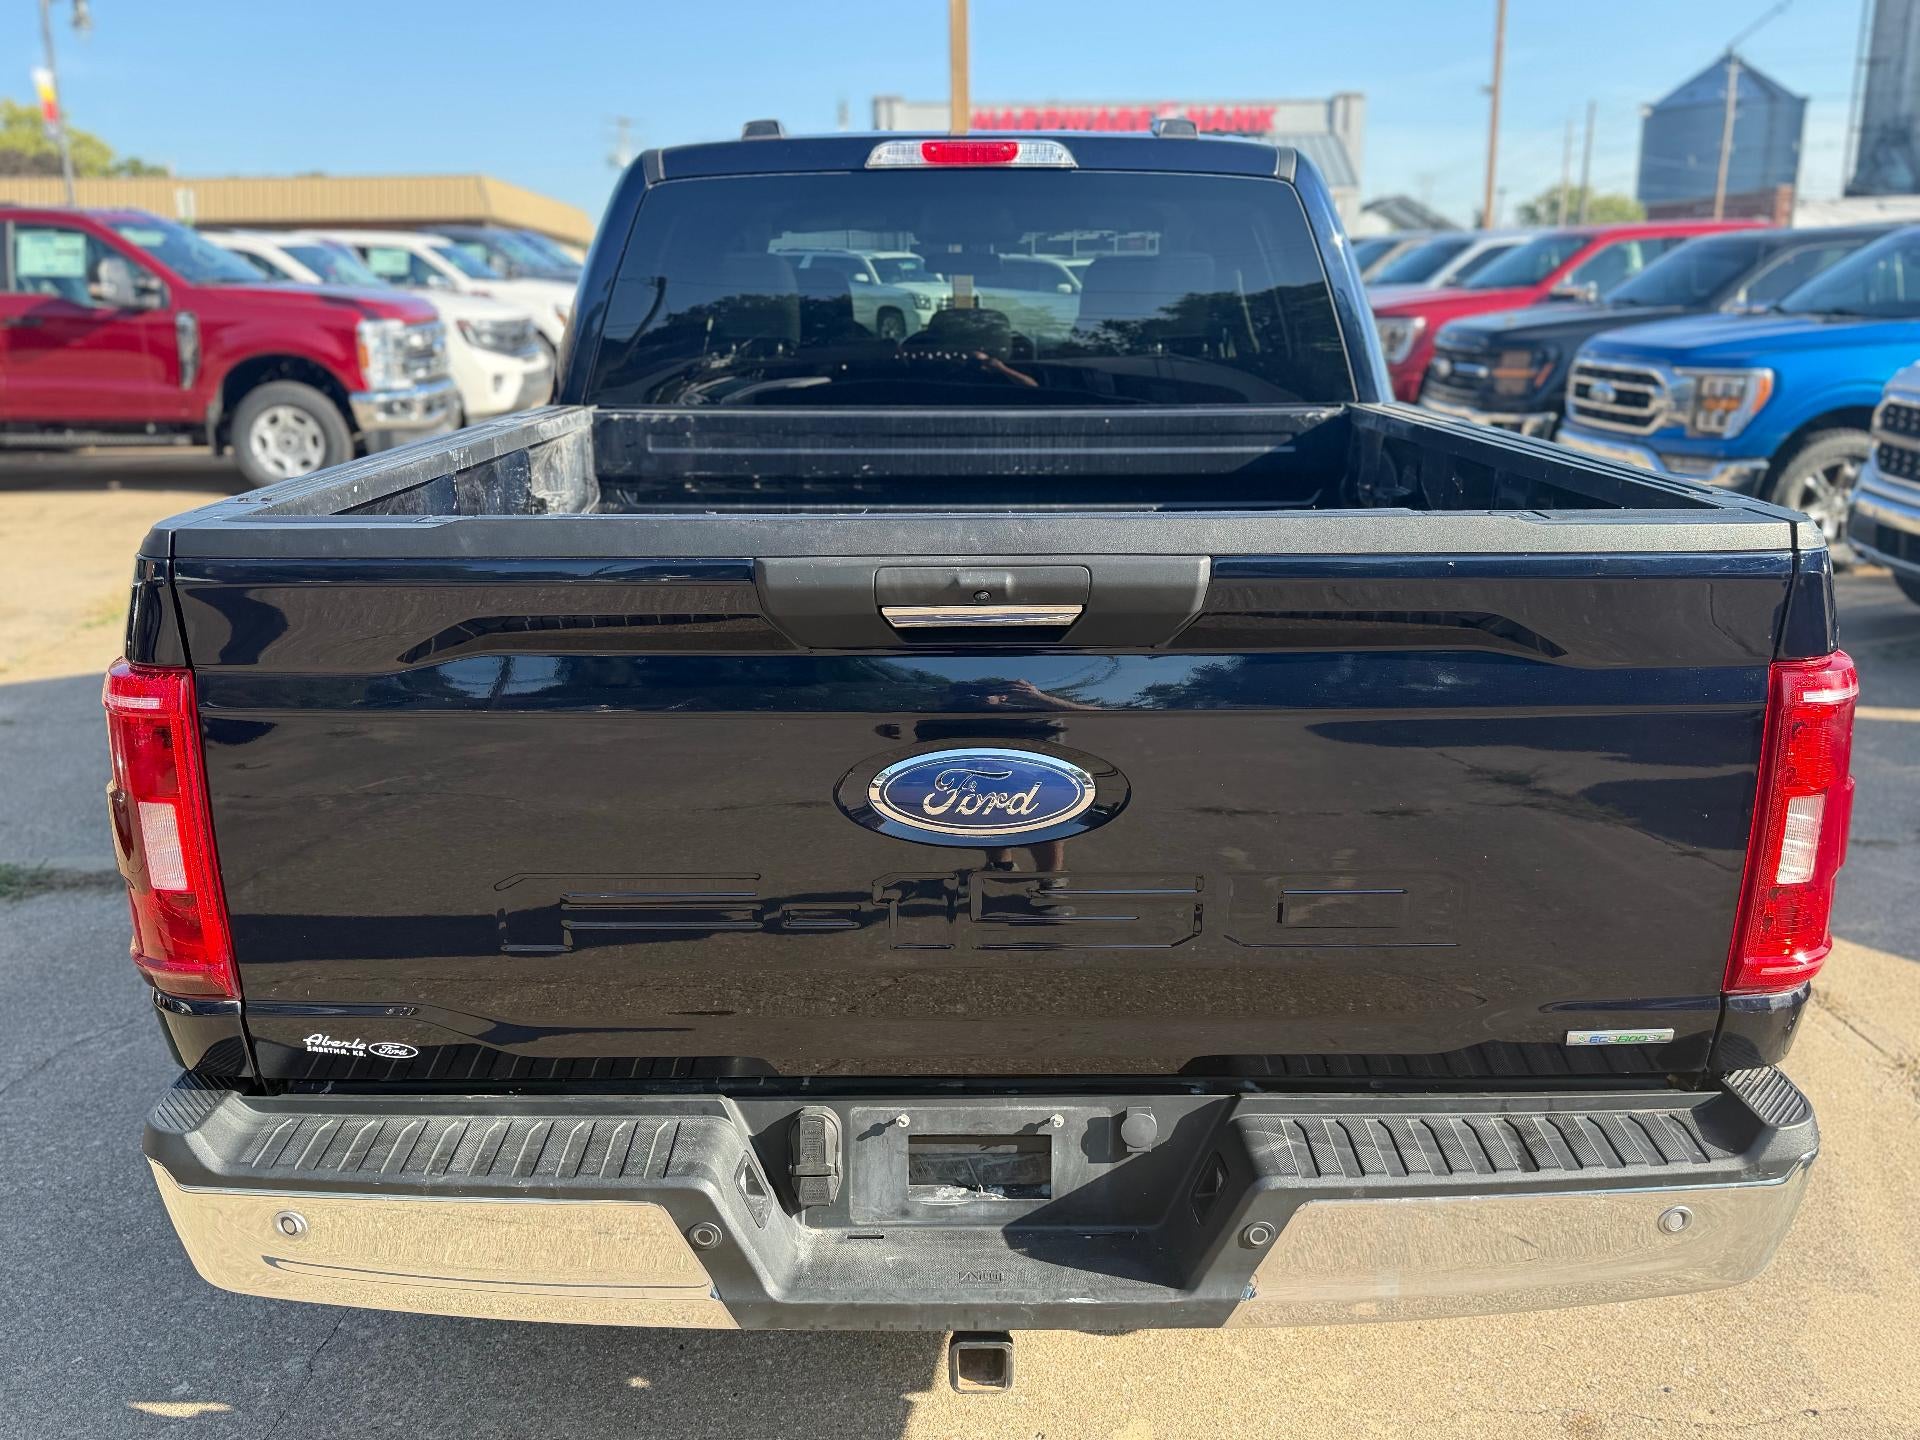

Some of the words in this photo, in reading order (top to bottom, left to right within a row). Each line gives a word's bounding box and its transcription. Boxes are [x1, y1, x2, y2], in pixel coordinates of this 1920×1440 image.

[922, 768, 1042, 817] Ford
[303, 1033, 367, 1050] Aberle
[378, 1044, 408, 1057] Ford
